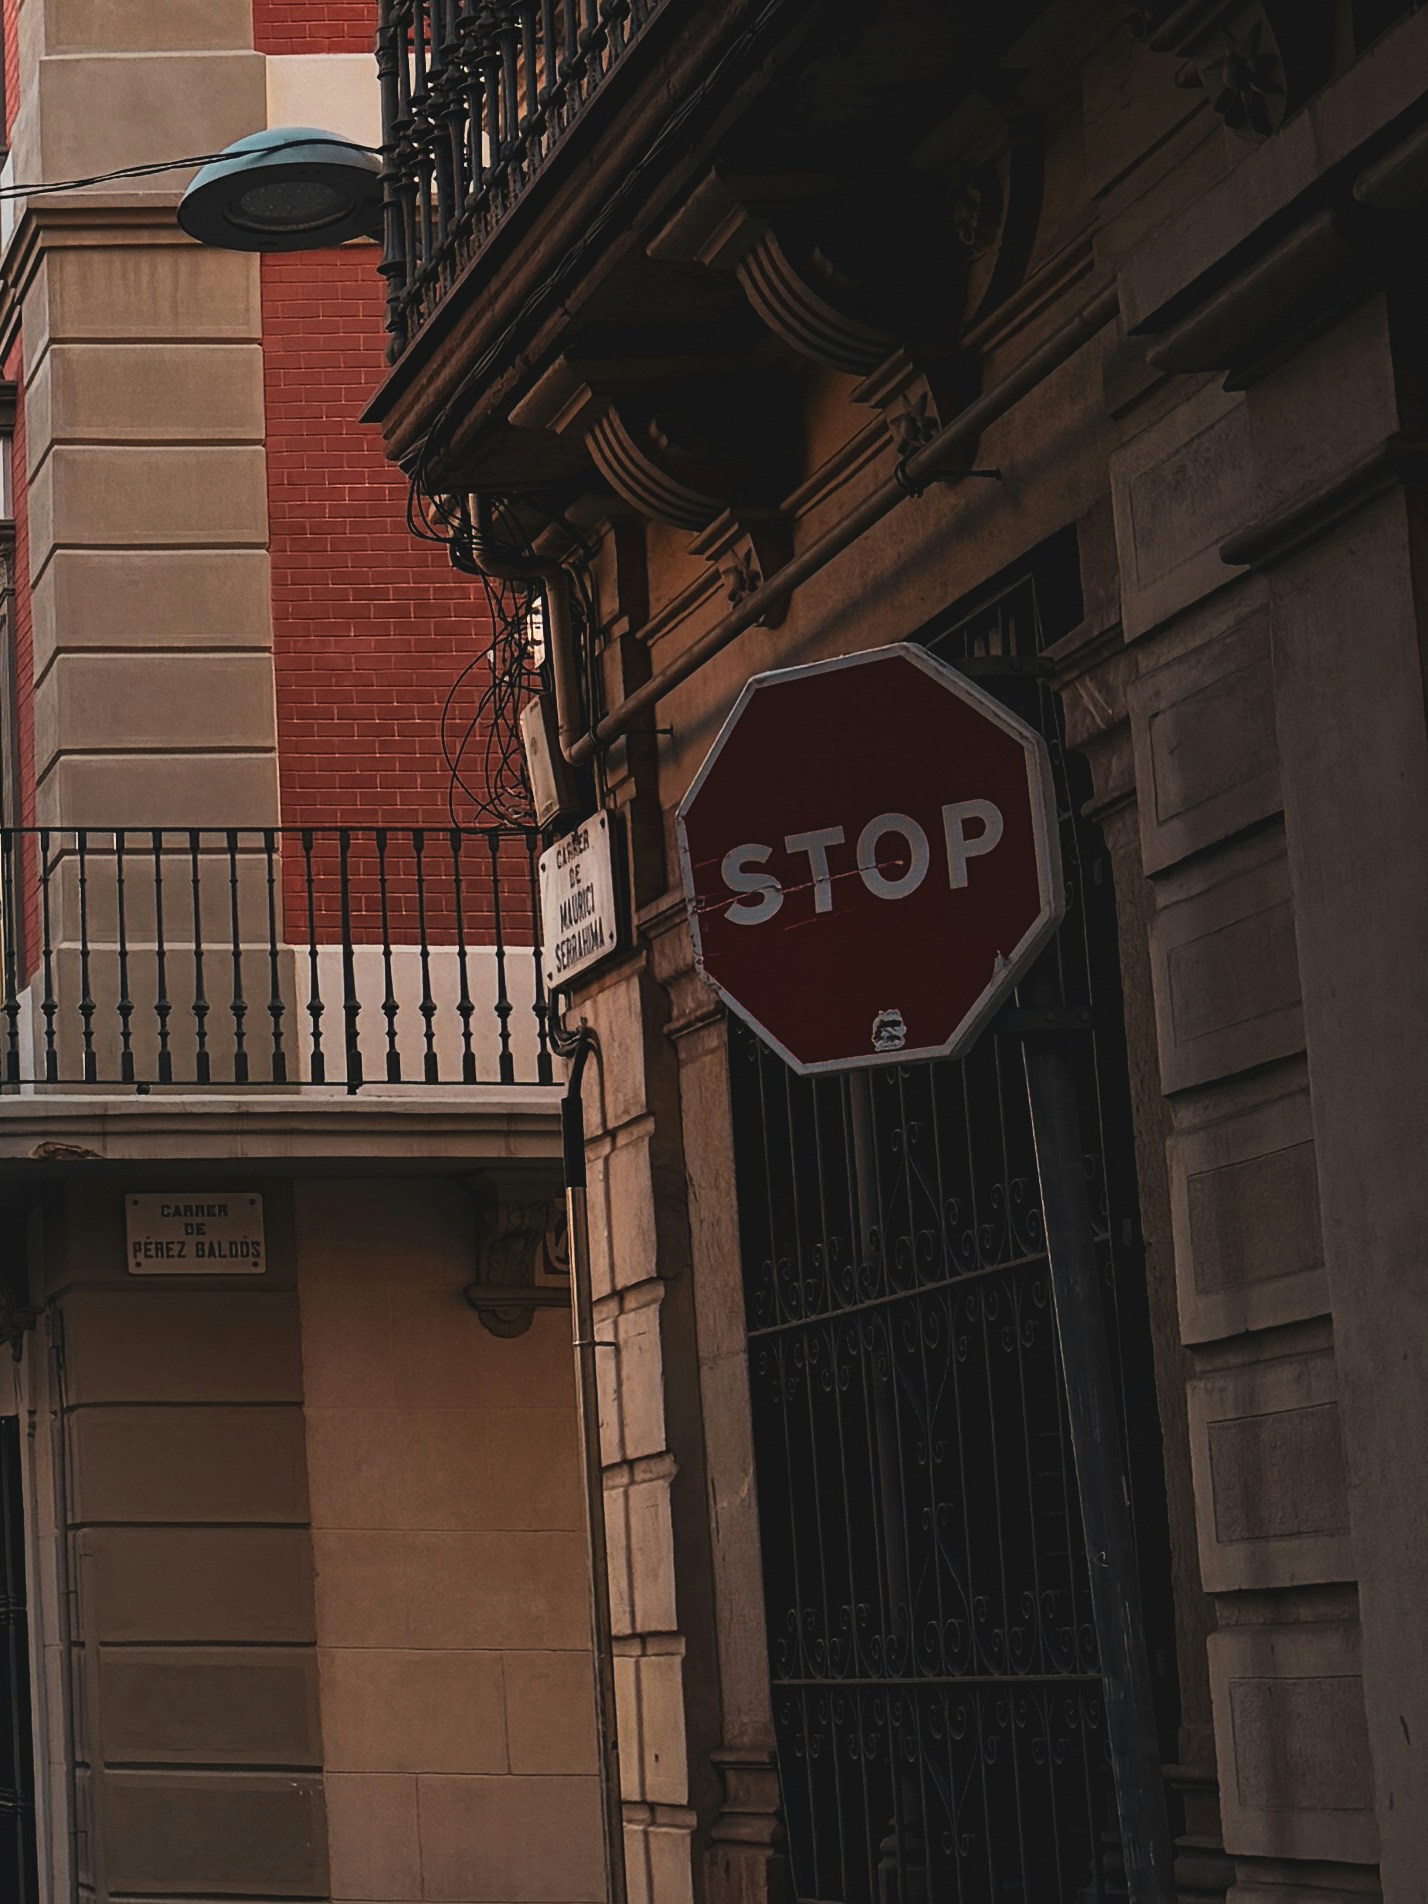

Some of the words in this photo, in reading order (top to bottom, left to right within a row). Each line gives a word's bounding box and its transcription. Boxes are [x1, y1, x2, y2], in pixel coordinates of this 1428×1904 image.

[721, 798, 1004, 926] STOP
[569, 864, 581, 889] DE
[559, 883, 595, 934] MAURICI
[555, 917, 605, 973] SERRAHIMA
[160, 1204, 228, 1218] CARRER
[184, 1223, 207, 1236] DE
[133, 1236, 187, 1259] PÉREZ
